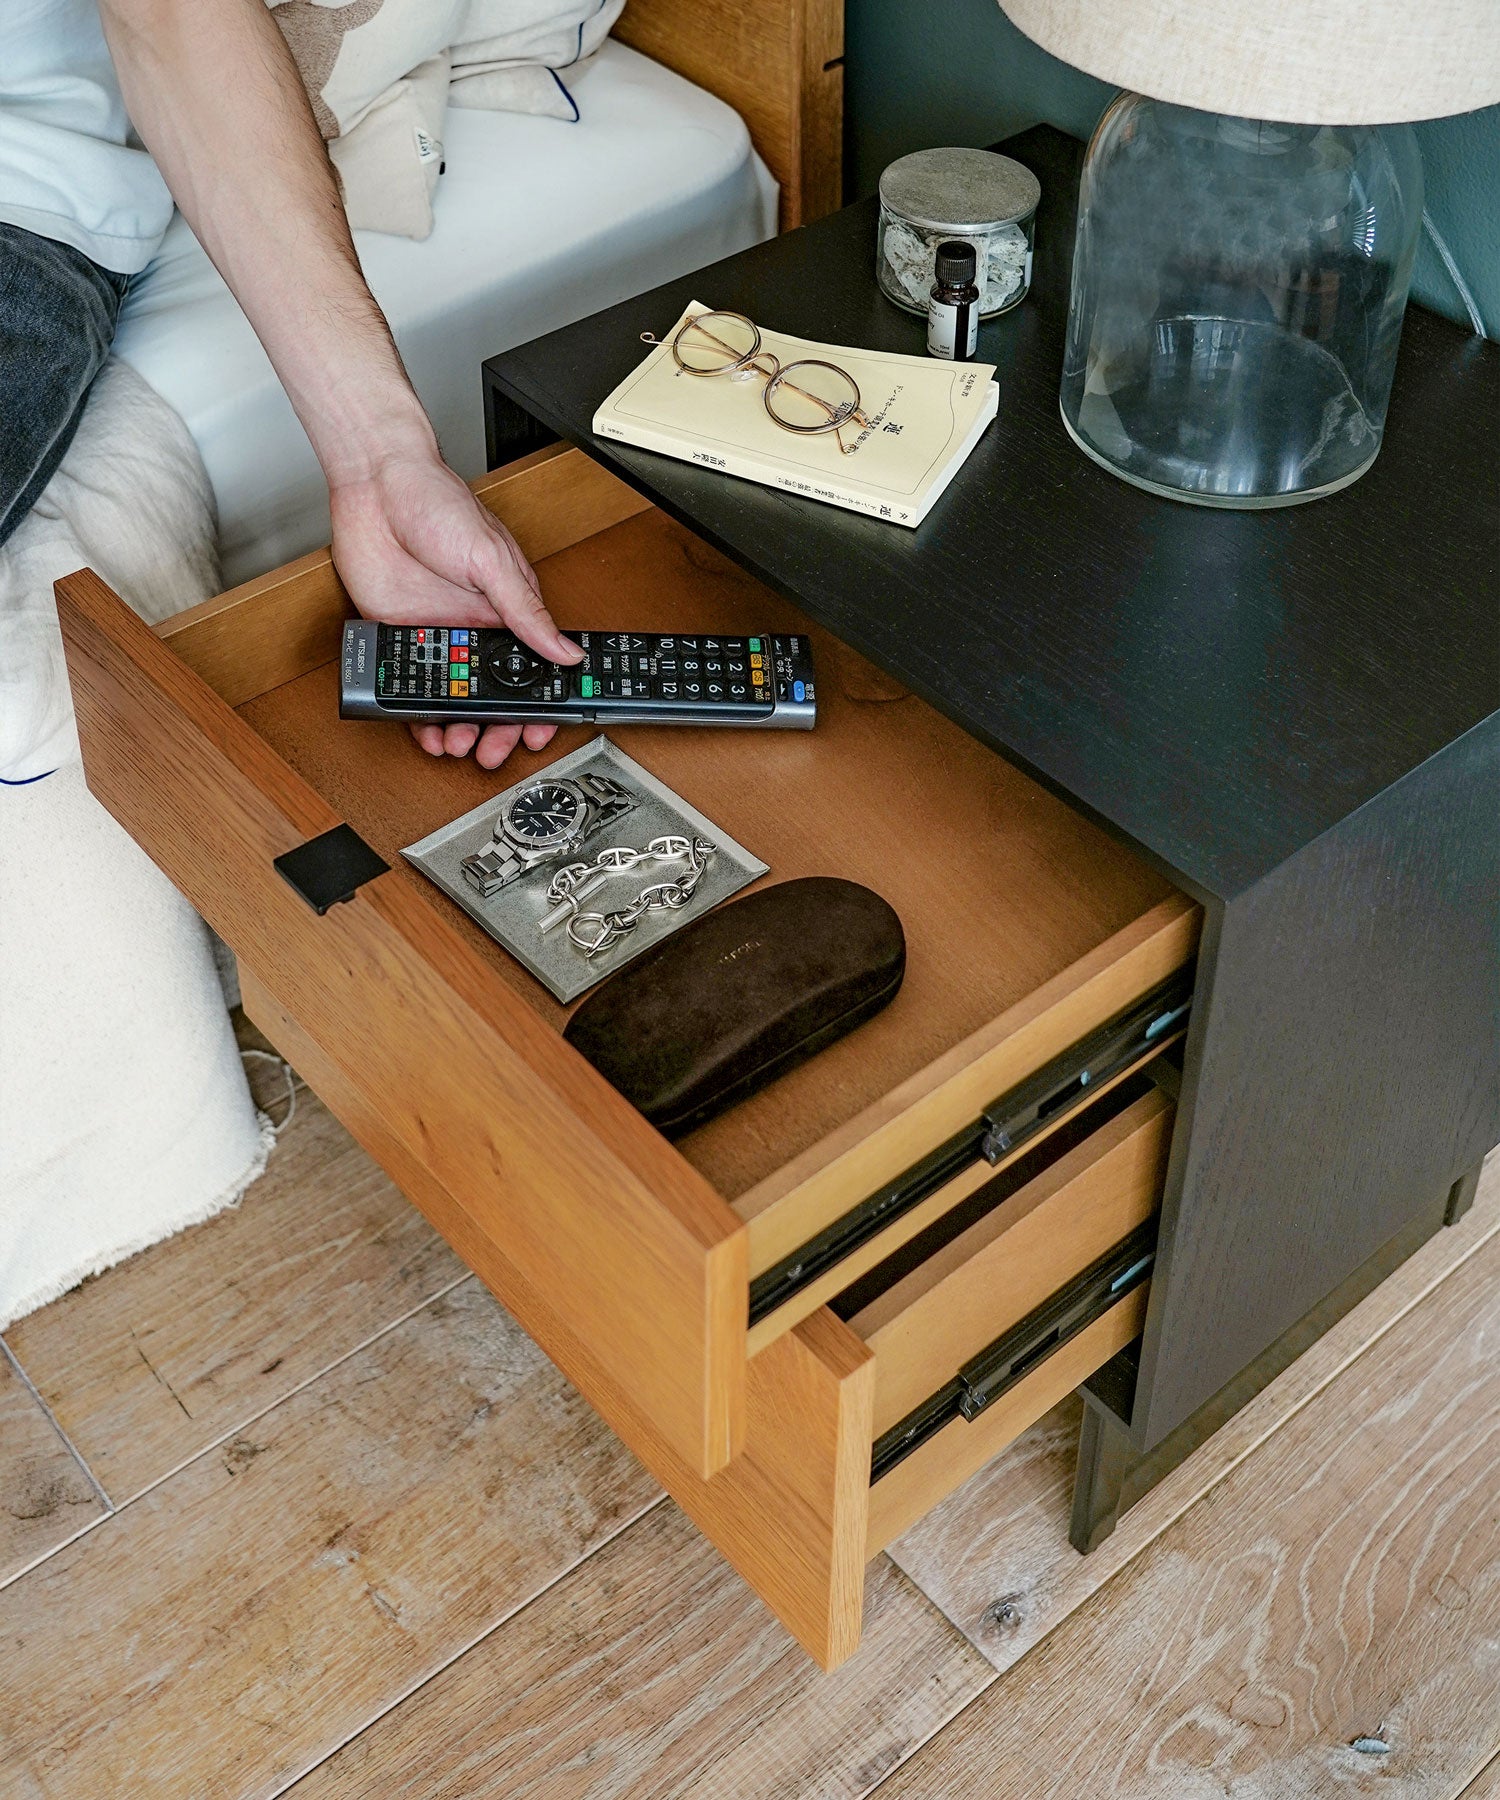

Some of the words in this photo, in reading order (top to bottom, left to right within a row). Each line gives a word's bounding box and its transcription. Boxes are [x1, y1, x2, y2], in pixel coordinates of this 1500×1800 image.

[882, 421, 904, 436] 運
[692, 450, 726, 468] 安田隆夫
[660, 638, 674, 648] 10
[682, 640, 696, 648] 7
[705, 640, 719, 649] 4
[357, 639, 366, 673] MITSUBISHI
[753, 655, 760, 665] BS
[471, 655, 479, 668] 戻る
[662, 660, 675, 669] 11
[684, 661, 698, 669] 8
[707, 662, 721, 670] 5
[729, 663, 742, 671] 2
[754, 671, 762, 682] CS
[621, 679, 631, 696] 音量
[663, 682, 677, 693] 12
[686, 684, 699, 692] 9
[709, 685, 722, 693] 6
[731, 686, 745, 694] 3
[806, 684, 815, 700] 電源
